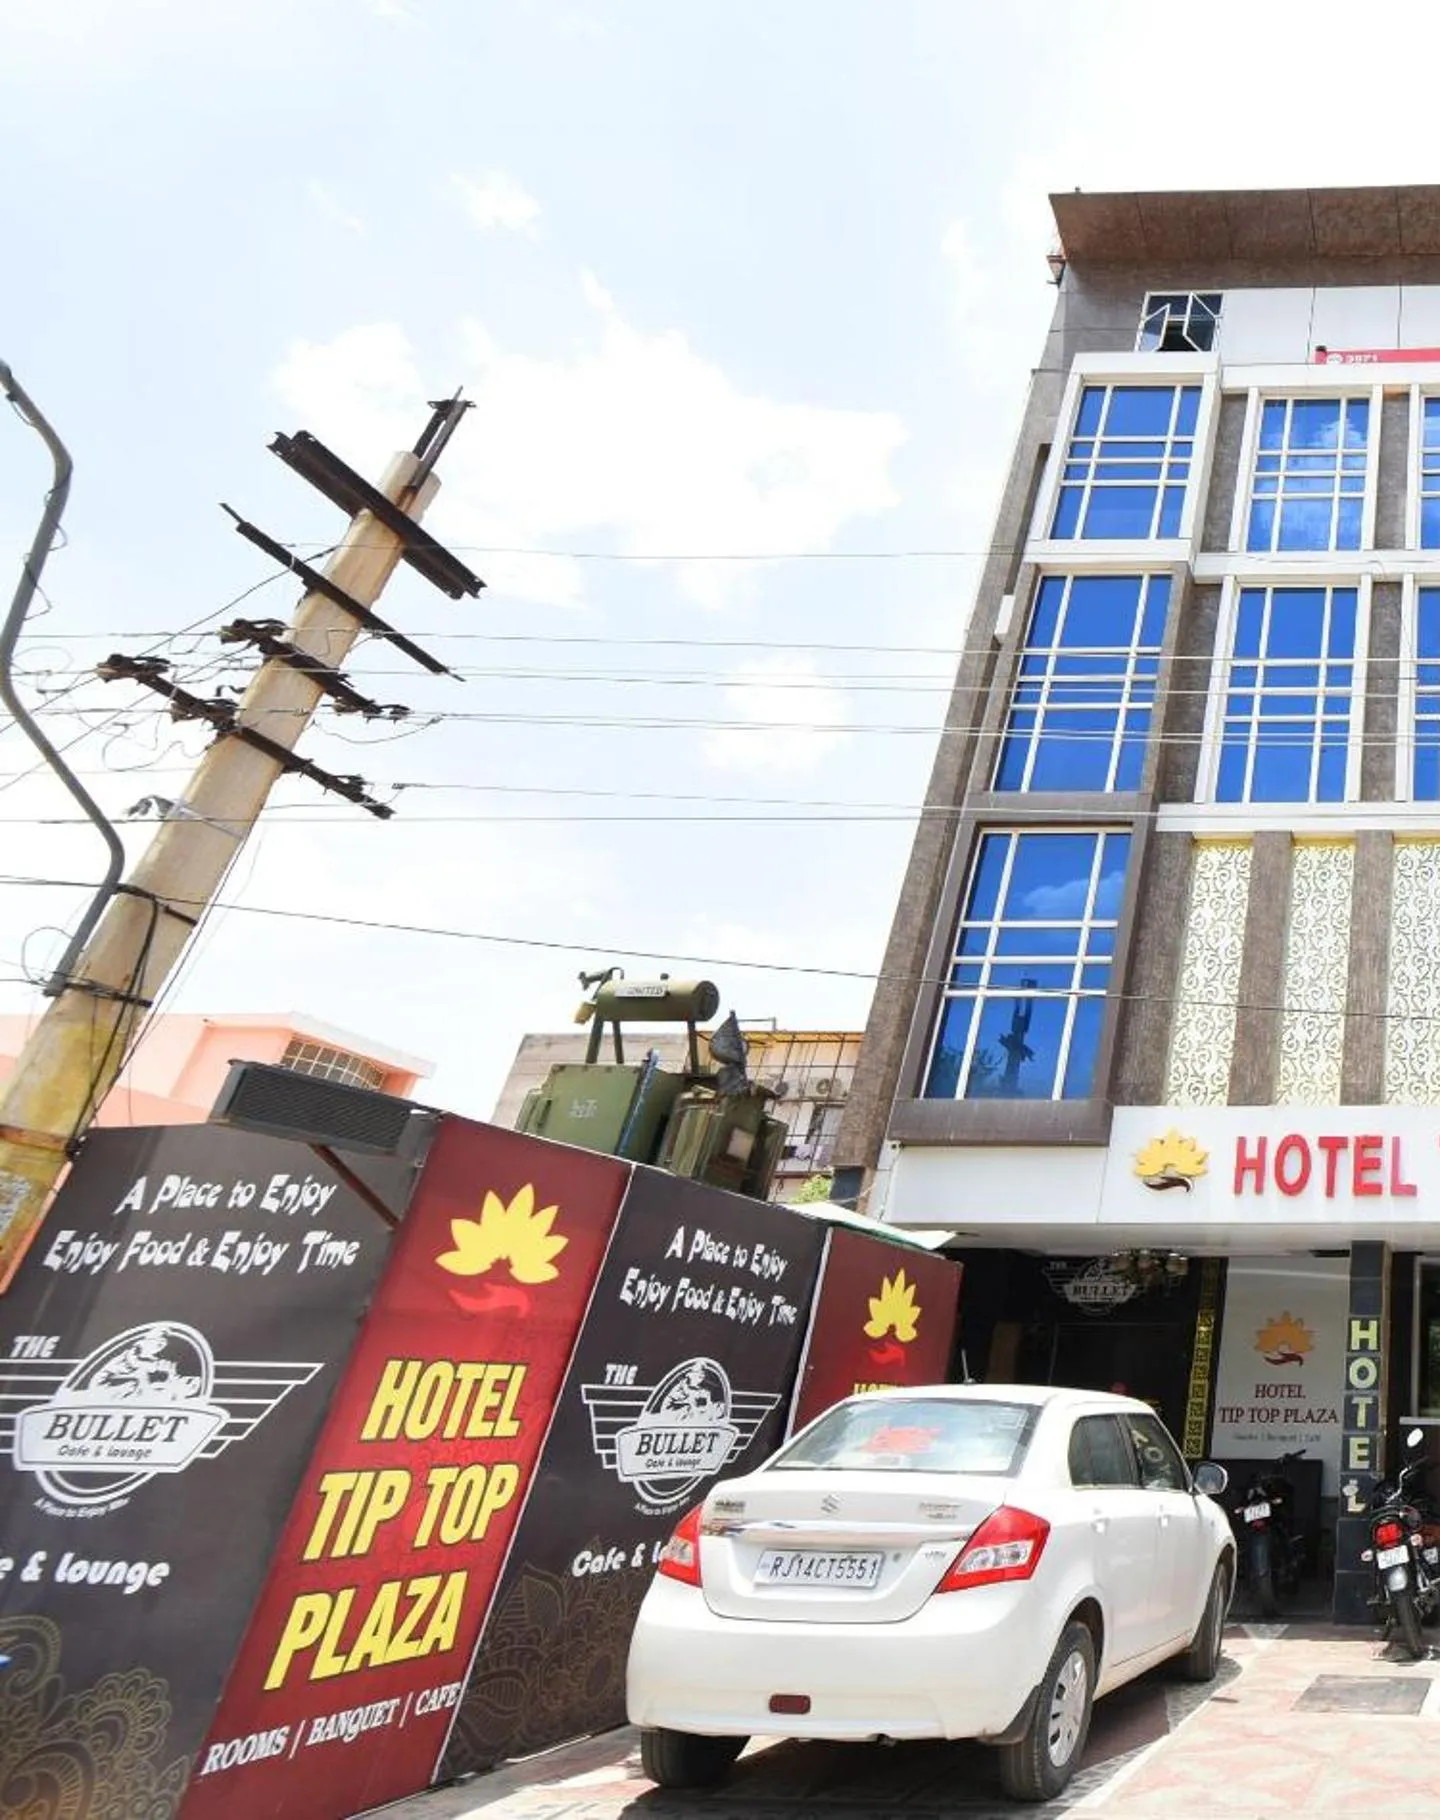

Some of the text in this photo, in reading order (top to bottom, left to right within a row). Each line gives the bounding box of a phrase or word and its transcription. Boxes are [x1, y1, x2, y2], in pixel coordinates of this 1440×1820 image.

[1233, 1134, 1418, 1198] HOTEL
[113, 1174, 338, 1216] A Place to Enjoy
[43, 1229, 360, 1275] Enjoy Food & Enjoy Time
[664, 1225, 788, 1283] A Place to Enjoy
[619, 1266, 671, 1312] Enjoy
[671, 1276, 715, 1312] Food
[712, 1290, 725, 1315] &
[725, 1285, 765, 1326] Enjoy
[9, 1336, 61, 1358] THE
[604, 1363, 638, 1385] THE
[1255, 1384, 1306, 1398] HOTEL
[360, 1359, 529, 1442] HOTEL
[1219, 1407, 1339, 1423] TIP TOP PLAZA
[44, 1413, 189, 1443] BULLET
[635, 1432, 720, 1456] BULLET
[302, 1463, 520, 1562] TIP TOP
[20, 1551, 47, 1582] &
[571, 1546, 627, 1578] Cafe
[631, 1543, 646, 1567] &
[263, 1570, 469, 1691] PLAZA
[201, 1728, 291, 1776] ROOMS
[307, 1695, 401, 1747] BANQUET
[414, 1681, 463, 1719] CAFE
